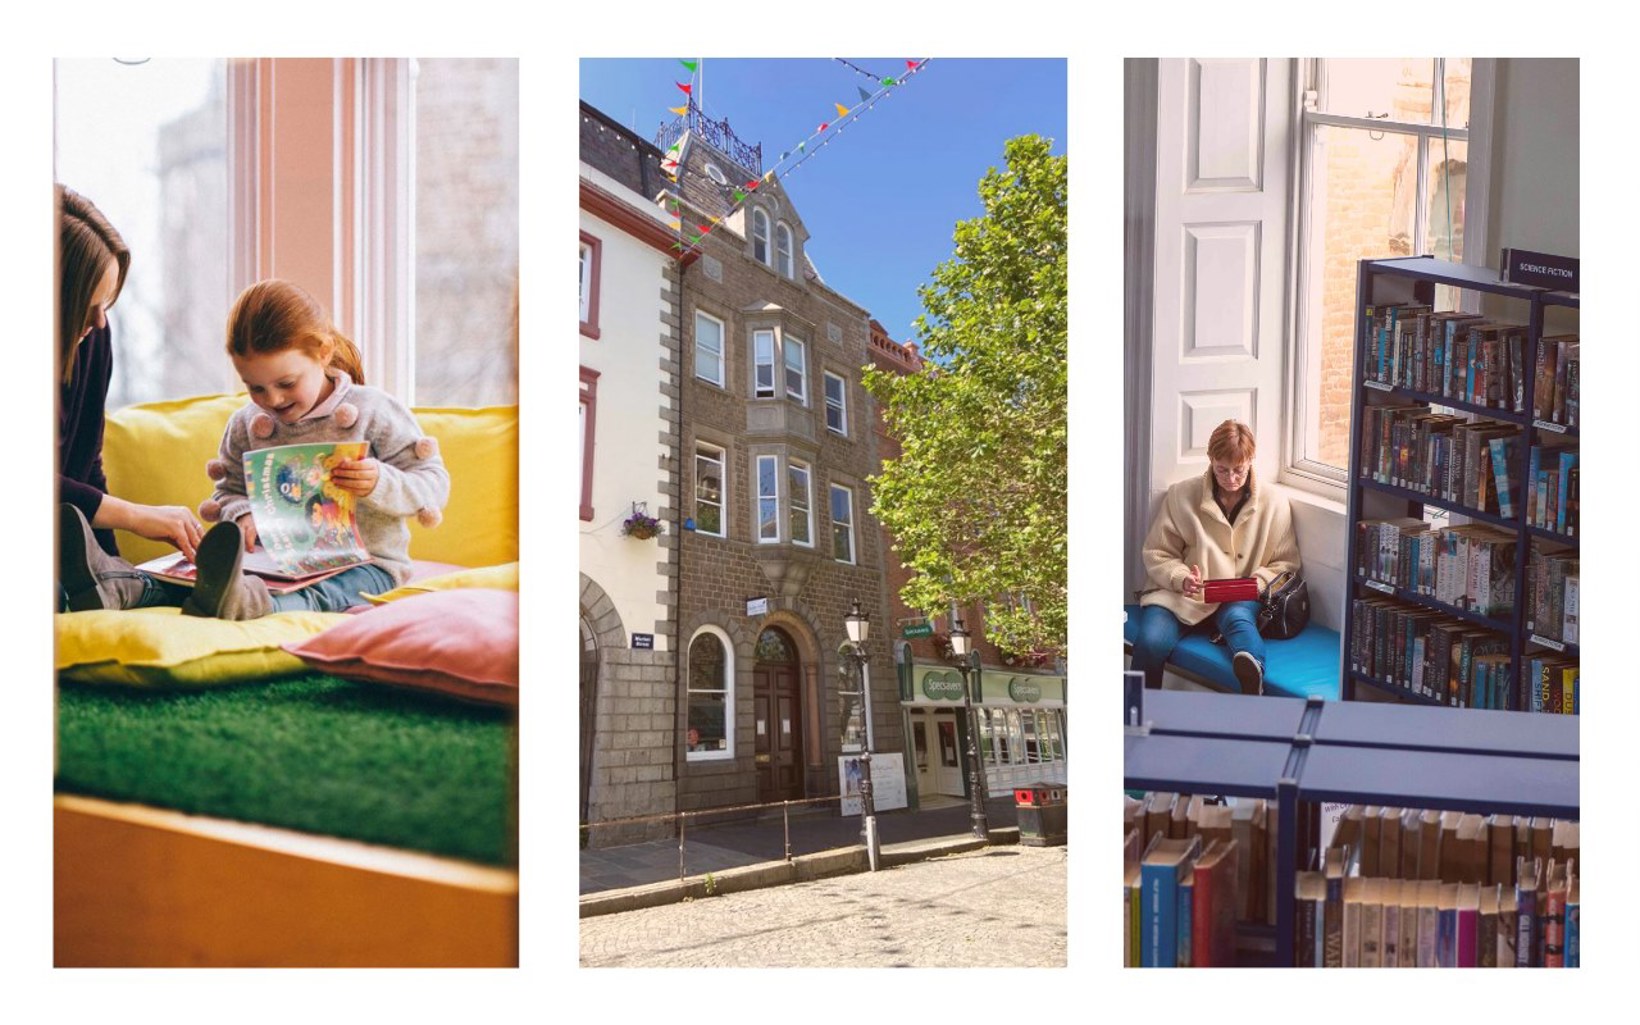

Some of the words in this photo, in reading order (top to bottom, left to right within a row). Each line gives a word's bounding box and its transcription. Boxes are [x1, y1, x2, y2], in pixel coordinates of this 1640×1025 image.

[1519, 262, 1547, 274] SCIENCE
[1547, 267, 1573, 279] FICTION
[928, 678, 962, 692] Specsavers
[1542, 666, 1550, 701] SAND
